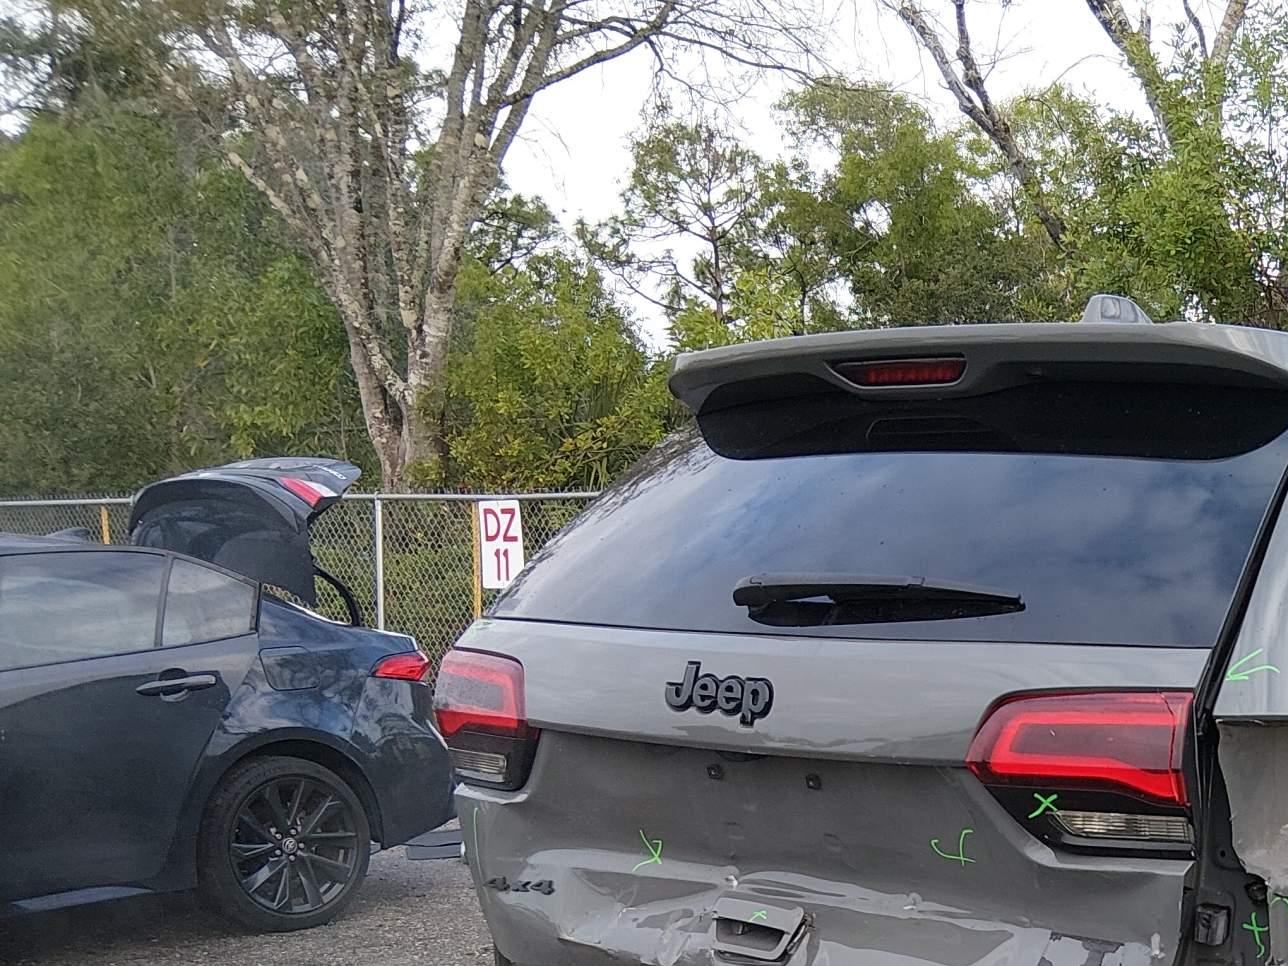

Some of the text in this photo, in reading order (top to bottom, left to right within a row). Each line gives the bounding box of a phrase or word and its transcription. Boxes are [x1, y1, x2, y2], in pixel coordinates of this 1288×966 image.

[483, 508, 519, 542] DZ
[494, 548, 510, 582] 11
[665, 660, 774, 728] Jeep
